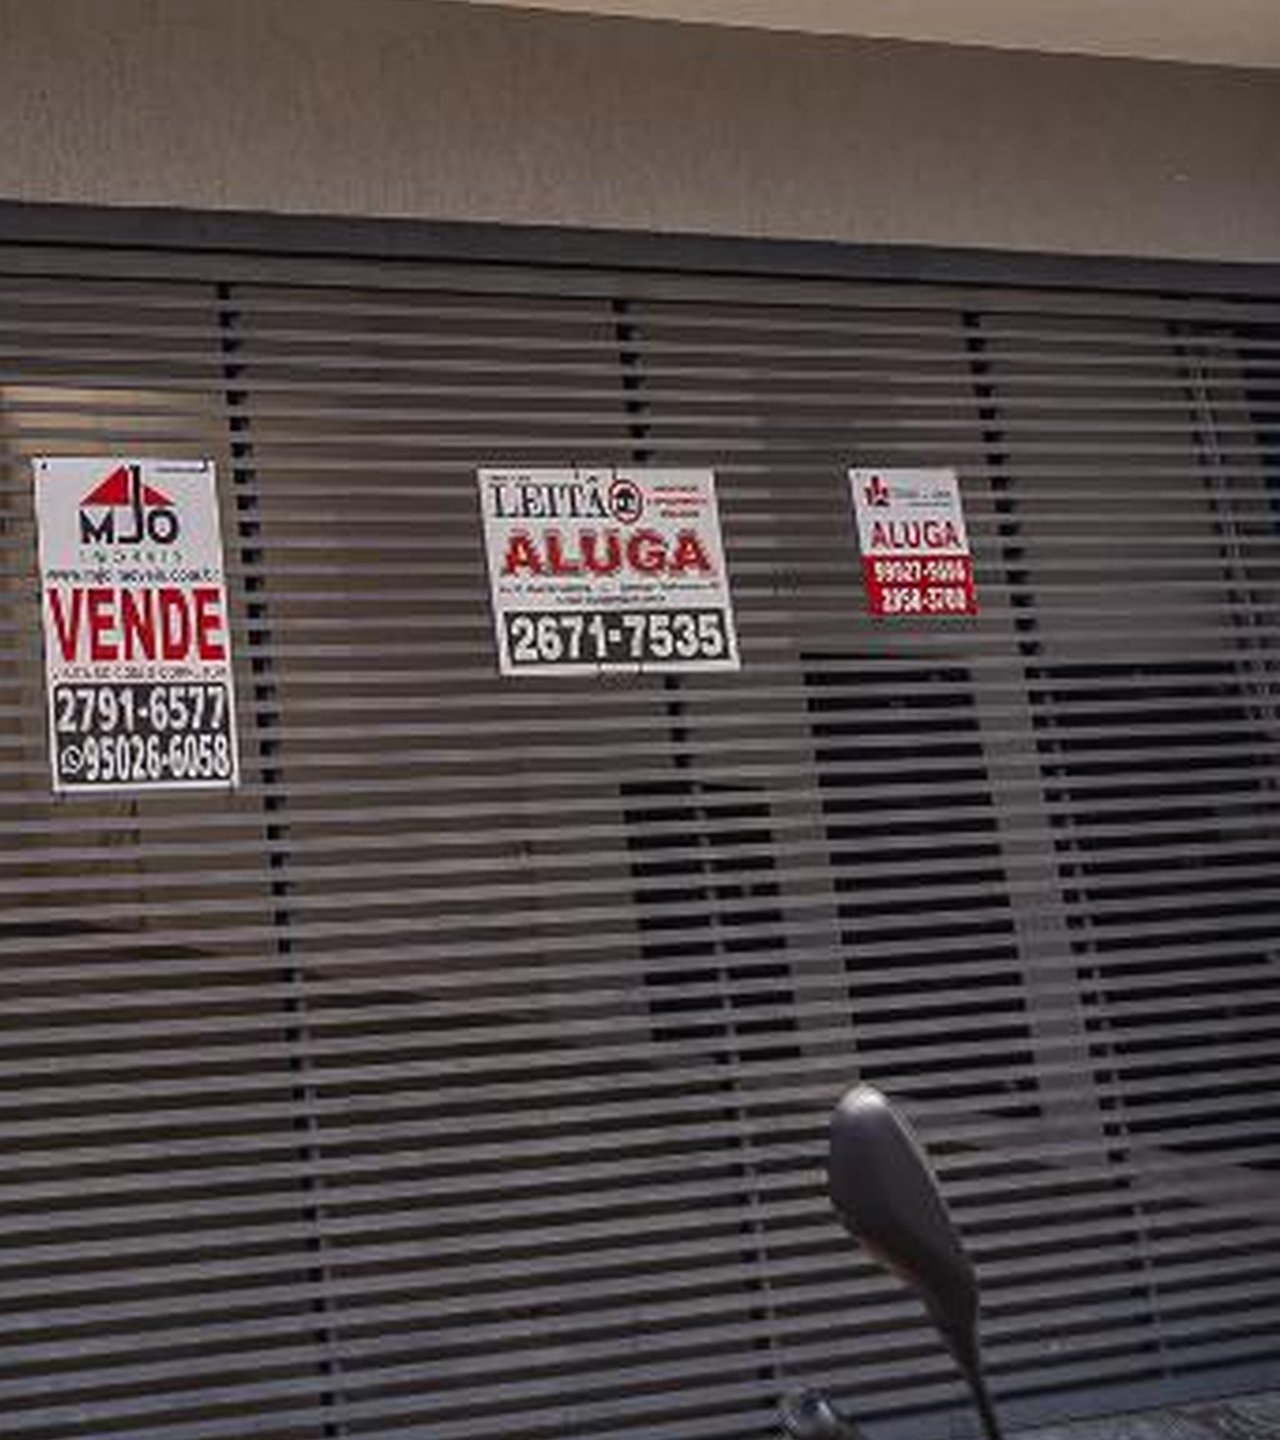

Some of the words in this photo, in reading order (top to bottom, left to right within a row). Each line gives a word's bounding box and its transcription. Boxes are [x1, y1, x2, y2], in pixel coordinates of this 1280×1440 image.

[79, 465, 180, 544] MJO
[502, 528, 717, 577] ALUGA
[871, 521, 961, 548] ALUGA
[46, 587, 227, 662] VENDE
[510, 613, 724, 661] 2671-7535
[56, 686, 225, 732] 2791-6577
[83, 733, 231, 780] 95026-6058
